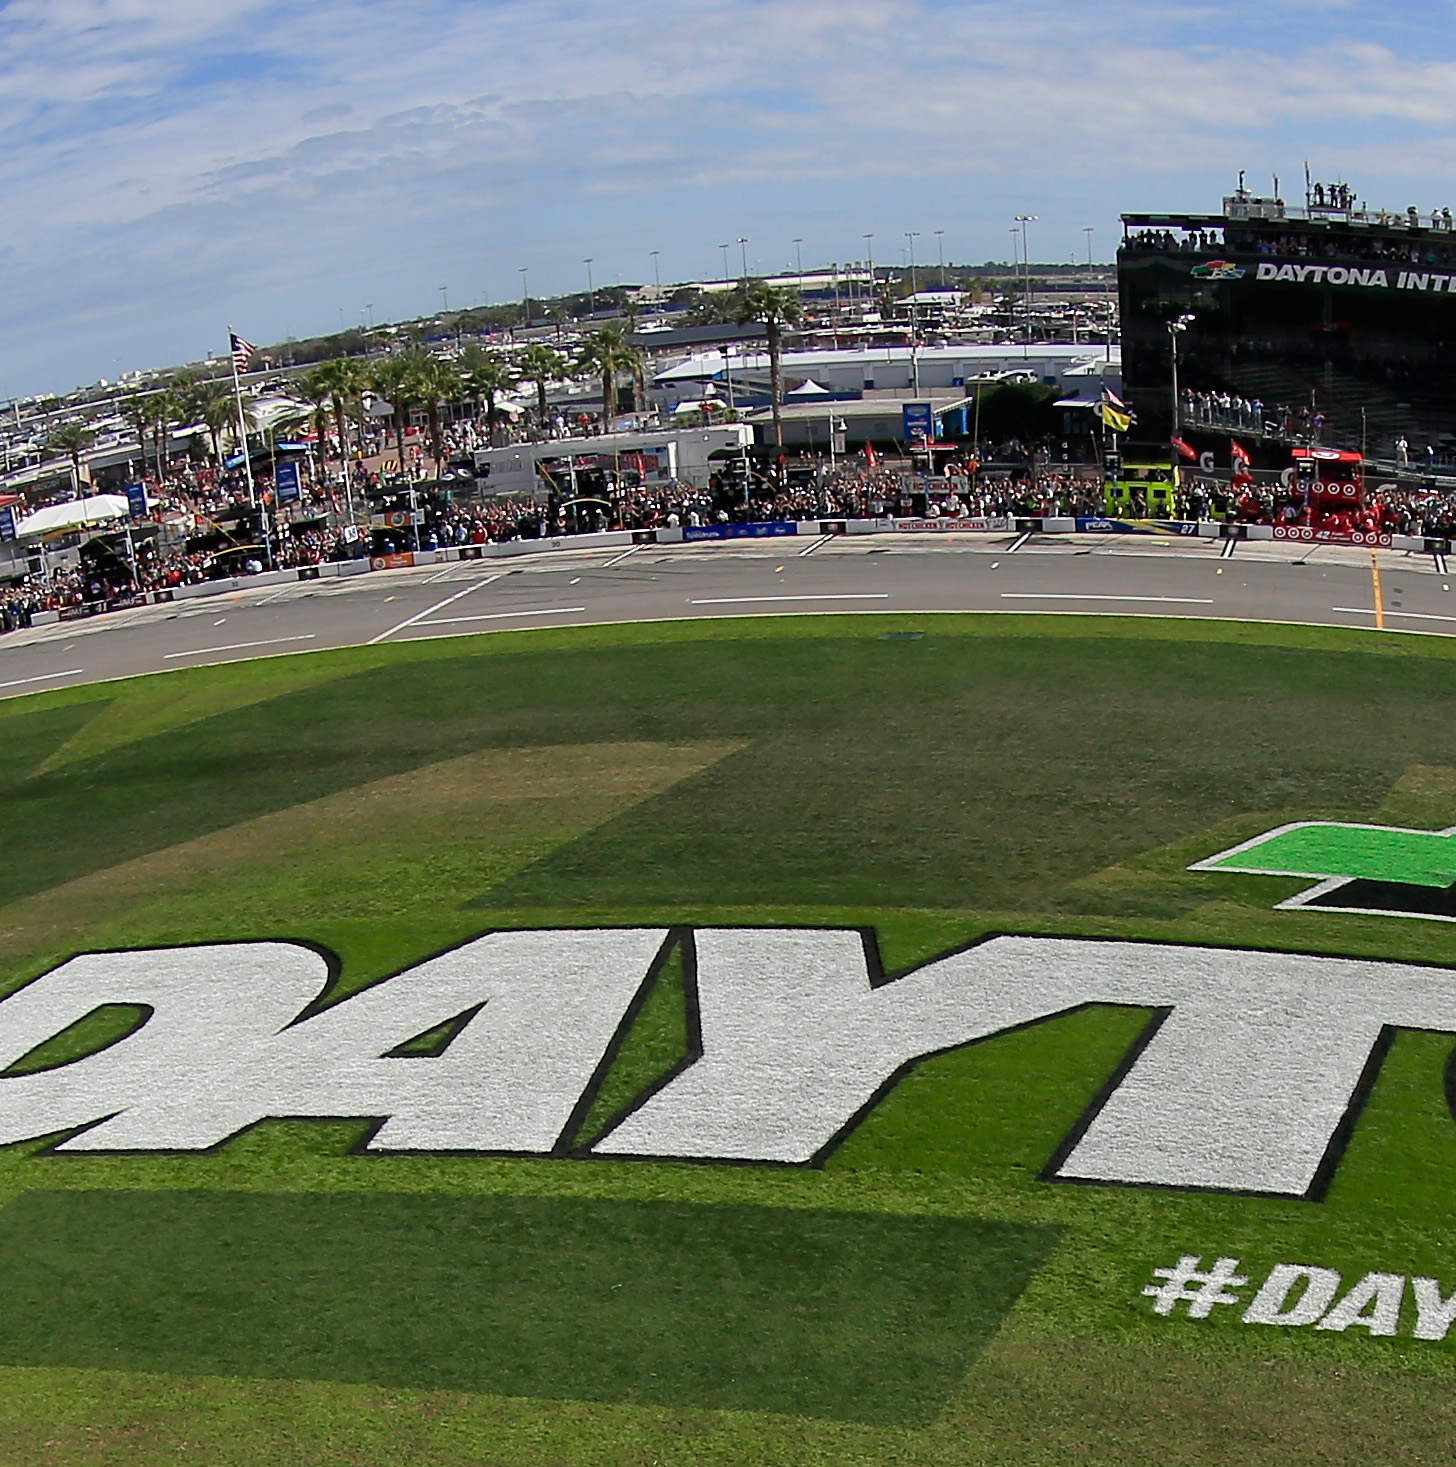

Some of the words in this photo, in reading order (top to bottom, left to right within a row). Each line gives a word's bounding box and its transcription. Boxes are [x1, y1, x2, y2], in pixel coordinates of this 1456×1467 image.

[1256, 263, 1388, 287] DAYTONA
[1200, 452, 1214, 473] G
[1181, 524, 1194, 535] 27
